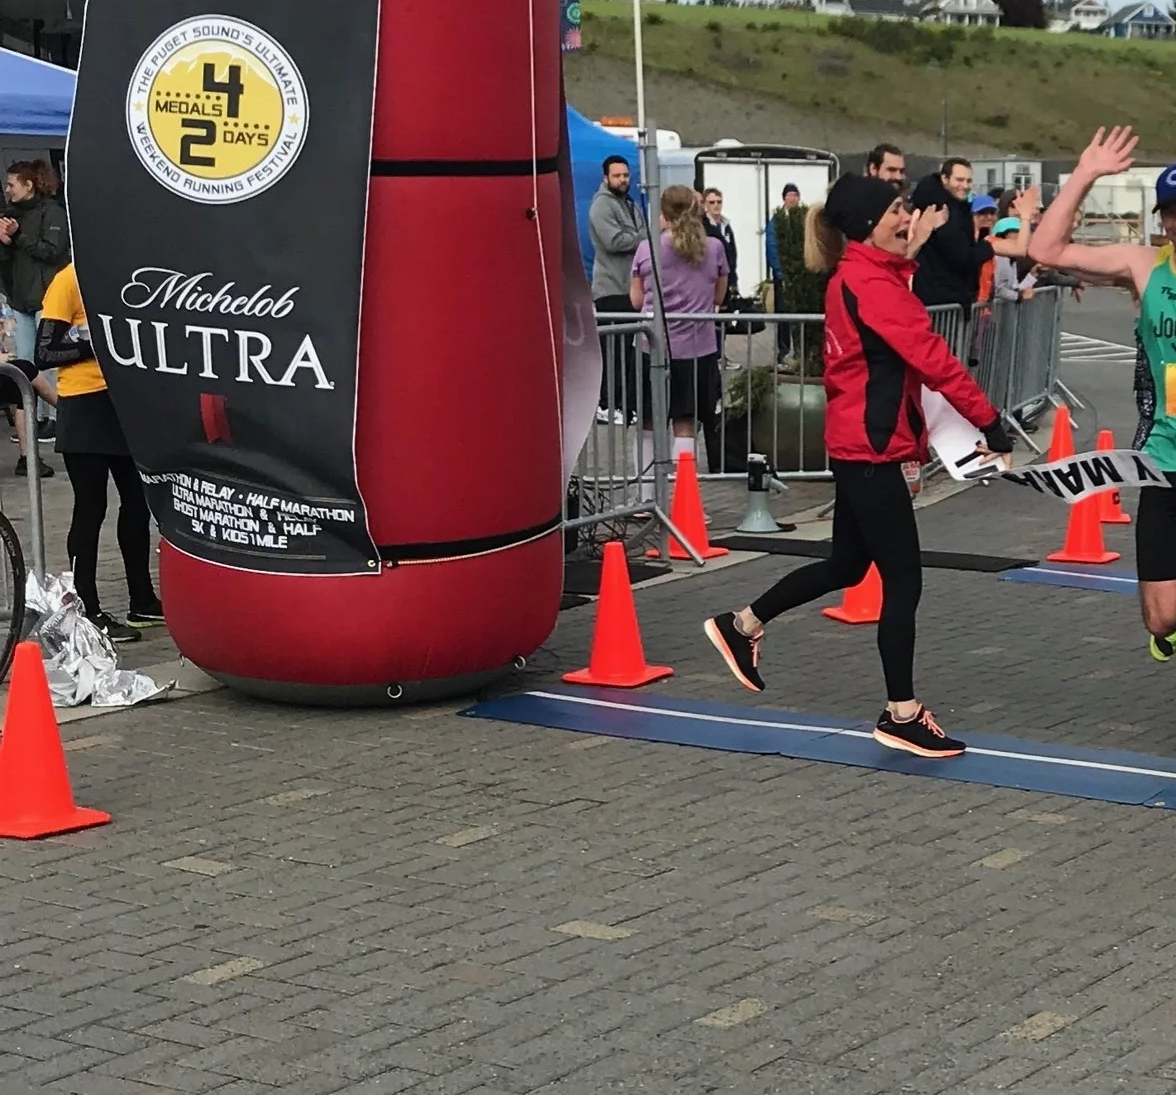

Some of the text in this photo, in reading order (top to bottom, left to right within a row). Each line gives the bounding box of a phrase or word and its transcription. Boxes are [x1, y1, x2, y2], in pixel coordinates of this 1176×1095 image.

[137, 25, 299, 107] THE PUGET SOUND'S ULTIMATE
[202, 62, 245, 118] 4
[155, 100, 224, 117] MEDALS
[135, 120, 298, 195] WEEKEND RUNNING FESTIVAL
[179, 118, 217, 168] 2
[223, 130, 270, 147] DAYS
[120, 266, 301, 319] Michelob
[97, 313, 335, 390] ULTRA
[139, 471, 192, 489] MARATHON
[201, 480, 235, 501] RELAY
[246, 492, 280, 510] HALF
[281, 499, 355, 523] MARATHON
[172, 483, 195, 504] ULTRA
[196, 491, 253, 518] MARATHON
[173, 497, 198, 519] GHOST
[199, 507, 260, 533] MARATHON
[283, 522, 322, 536] HALF
[222, 528, 250, 544] KIDS
[256, 533, 288, 549] MILE
